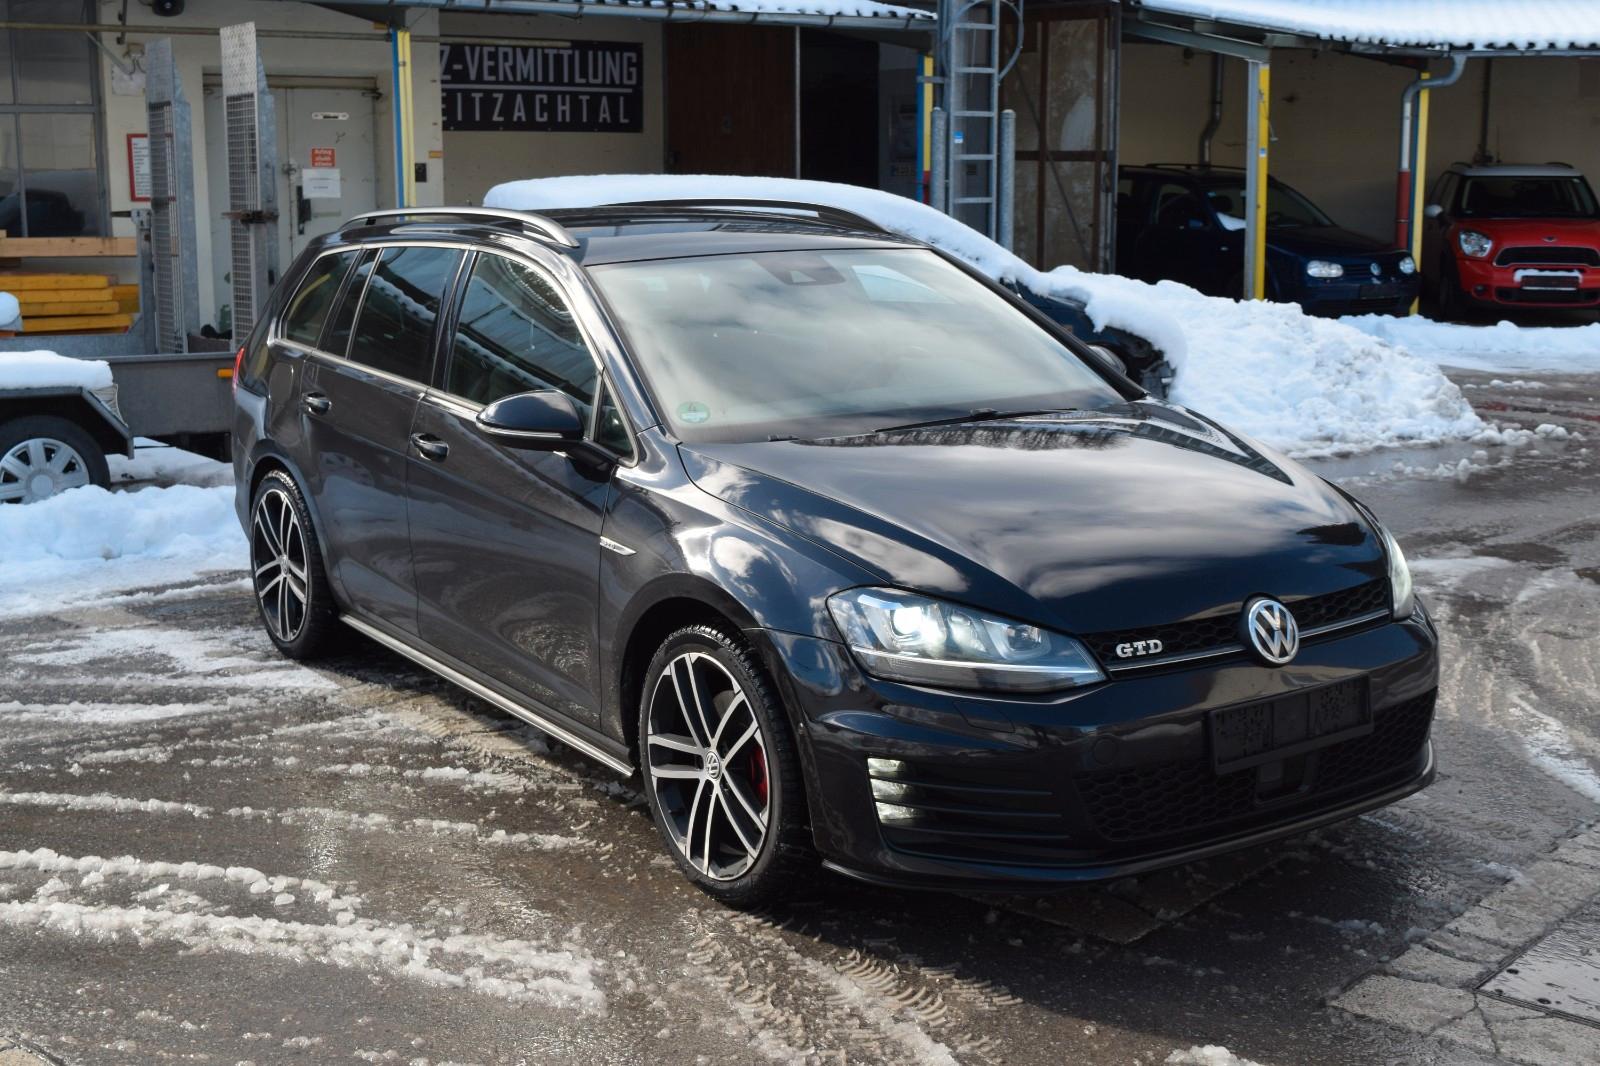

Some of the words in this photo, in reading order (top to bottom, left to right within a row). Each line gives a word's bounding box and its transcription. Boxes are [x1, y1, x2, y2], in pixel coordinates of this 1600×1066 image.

[440, 45, 637, 85] Z-VERMITTLUNG
[1115, 639, 1163, 658] GTD
[1250, 600, 1298, 663] VW
